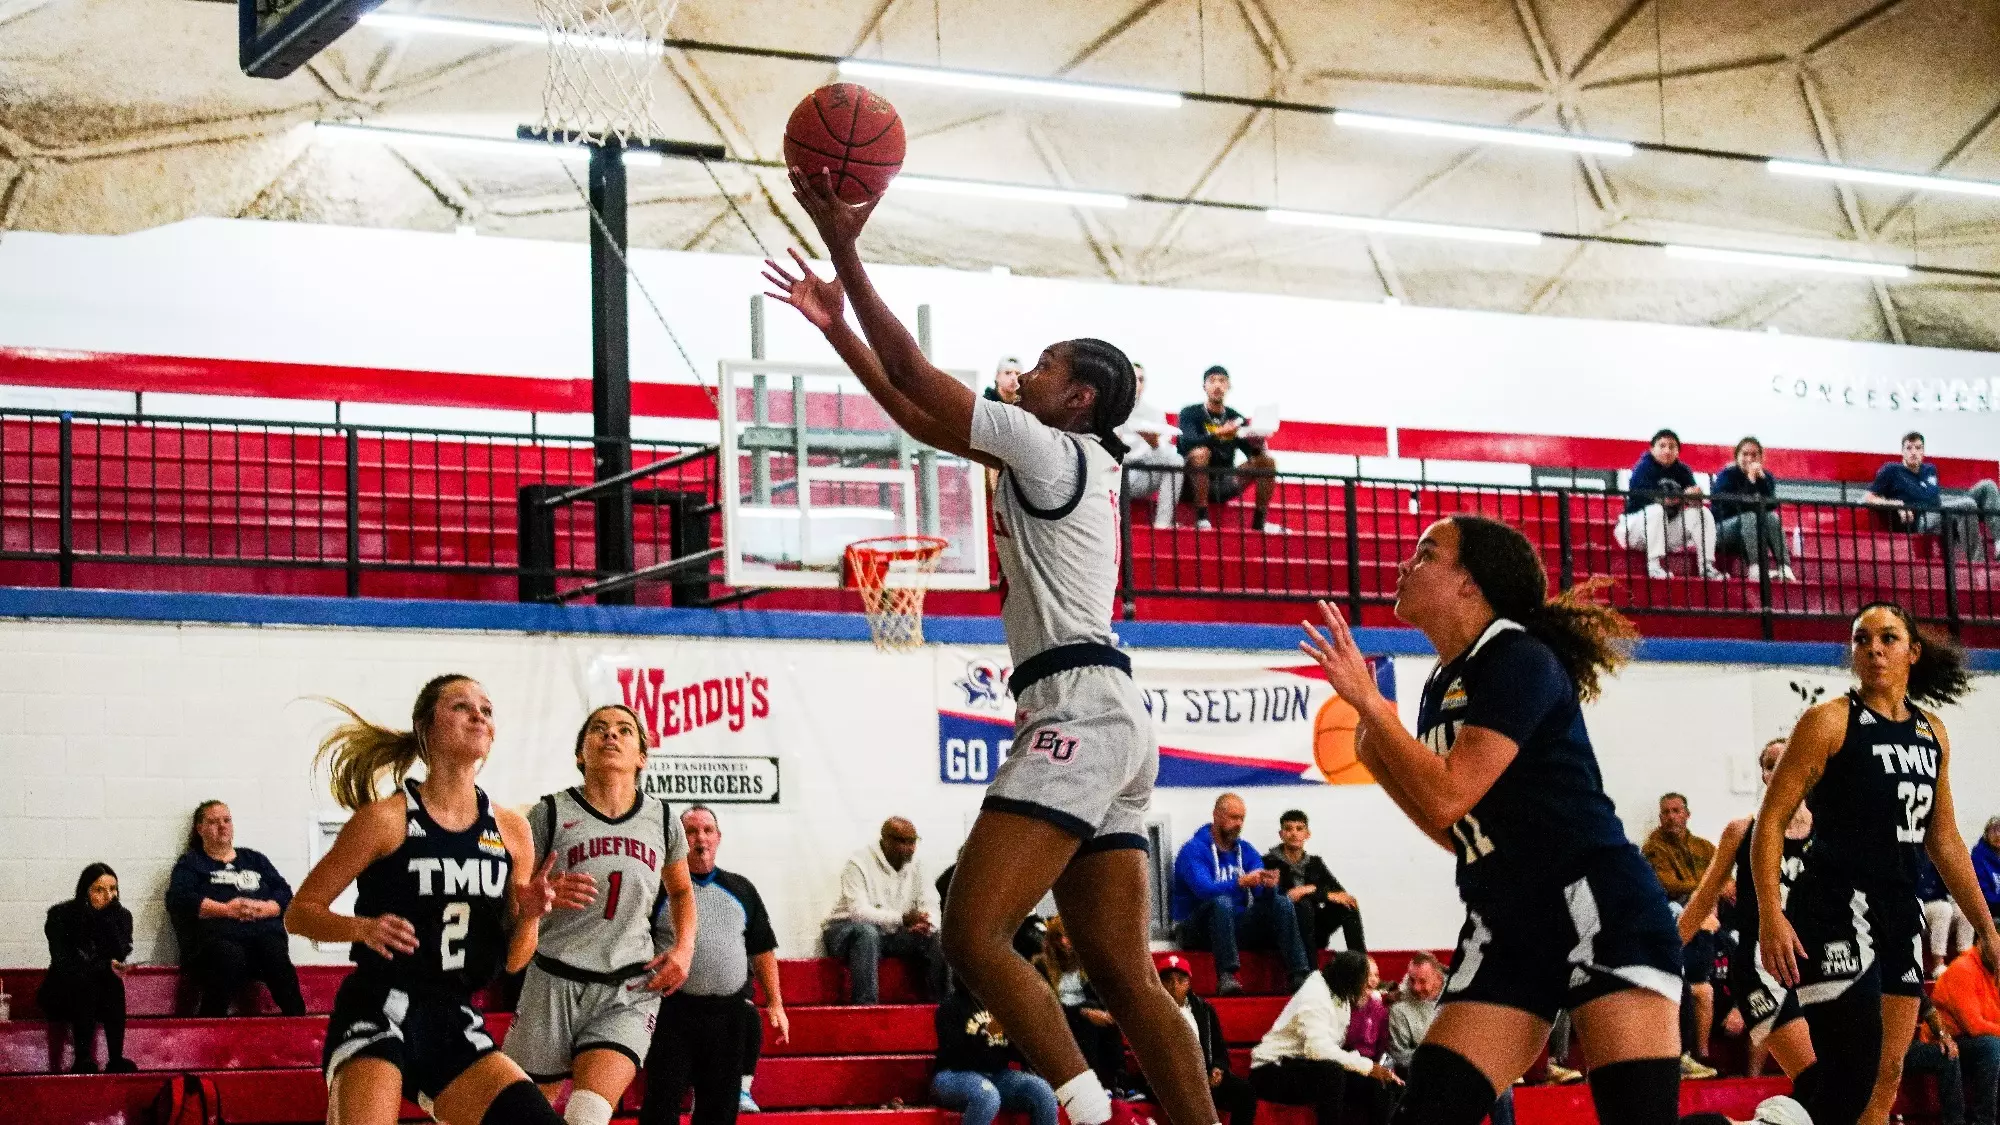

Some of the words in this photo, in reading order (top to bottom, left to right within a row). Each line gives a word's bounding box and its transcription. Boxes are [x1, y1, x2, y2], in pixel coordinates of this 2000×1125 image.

[1183, 685, 1310, 723] SECTION
[946, 738, 988, 780] GO
[1032, 728, 1078, 762] BU
[1872, 743, 1937, 779] TMU
[644, 774, 763, 794] AMBURGERS
[1896, 781, 1933, 843] 32
[567, 836, 657, 872] BLUEFIELD
[407, 857, 508, 899] TMU
[603, 870, 623, 921] 1
[440, 901, 471, 971] 2
